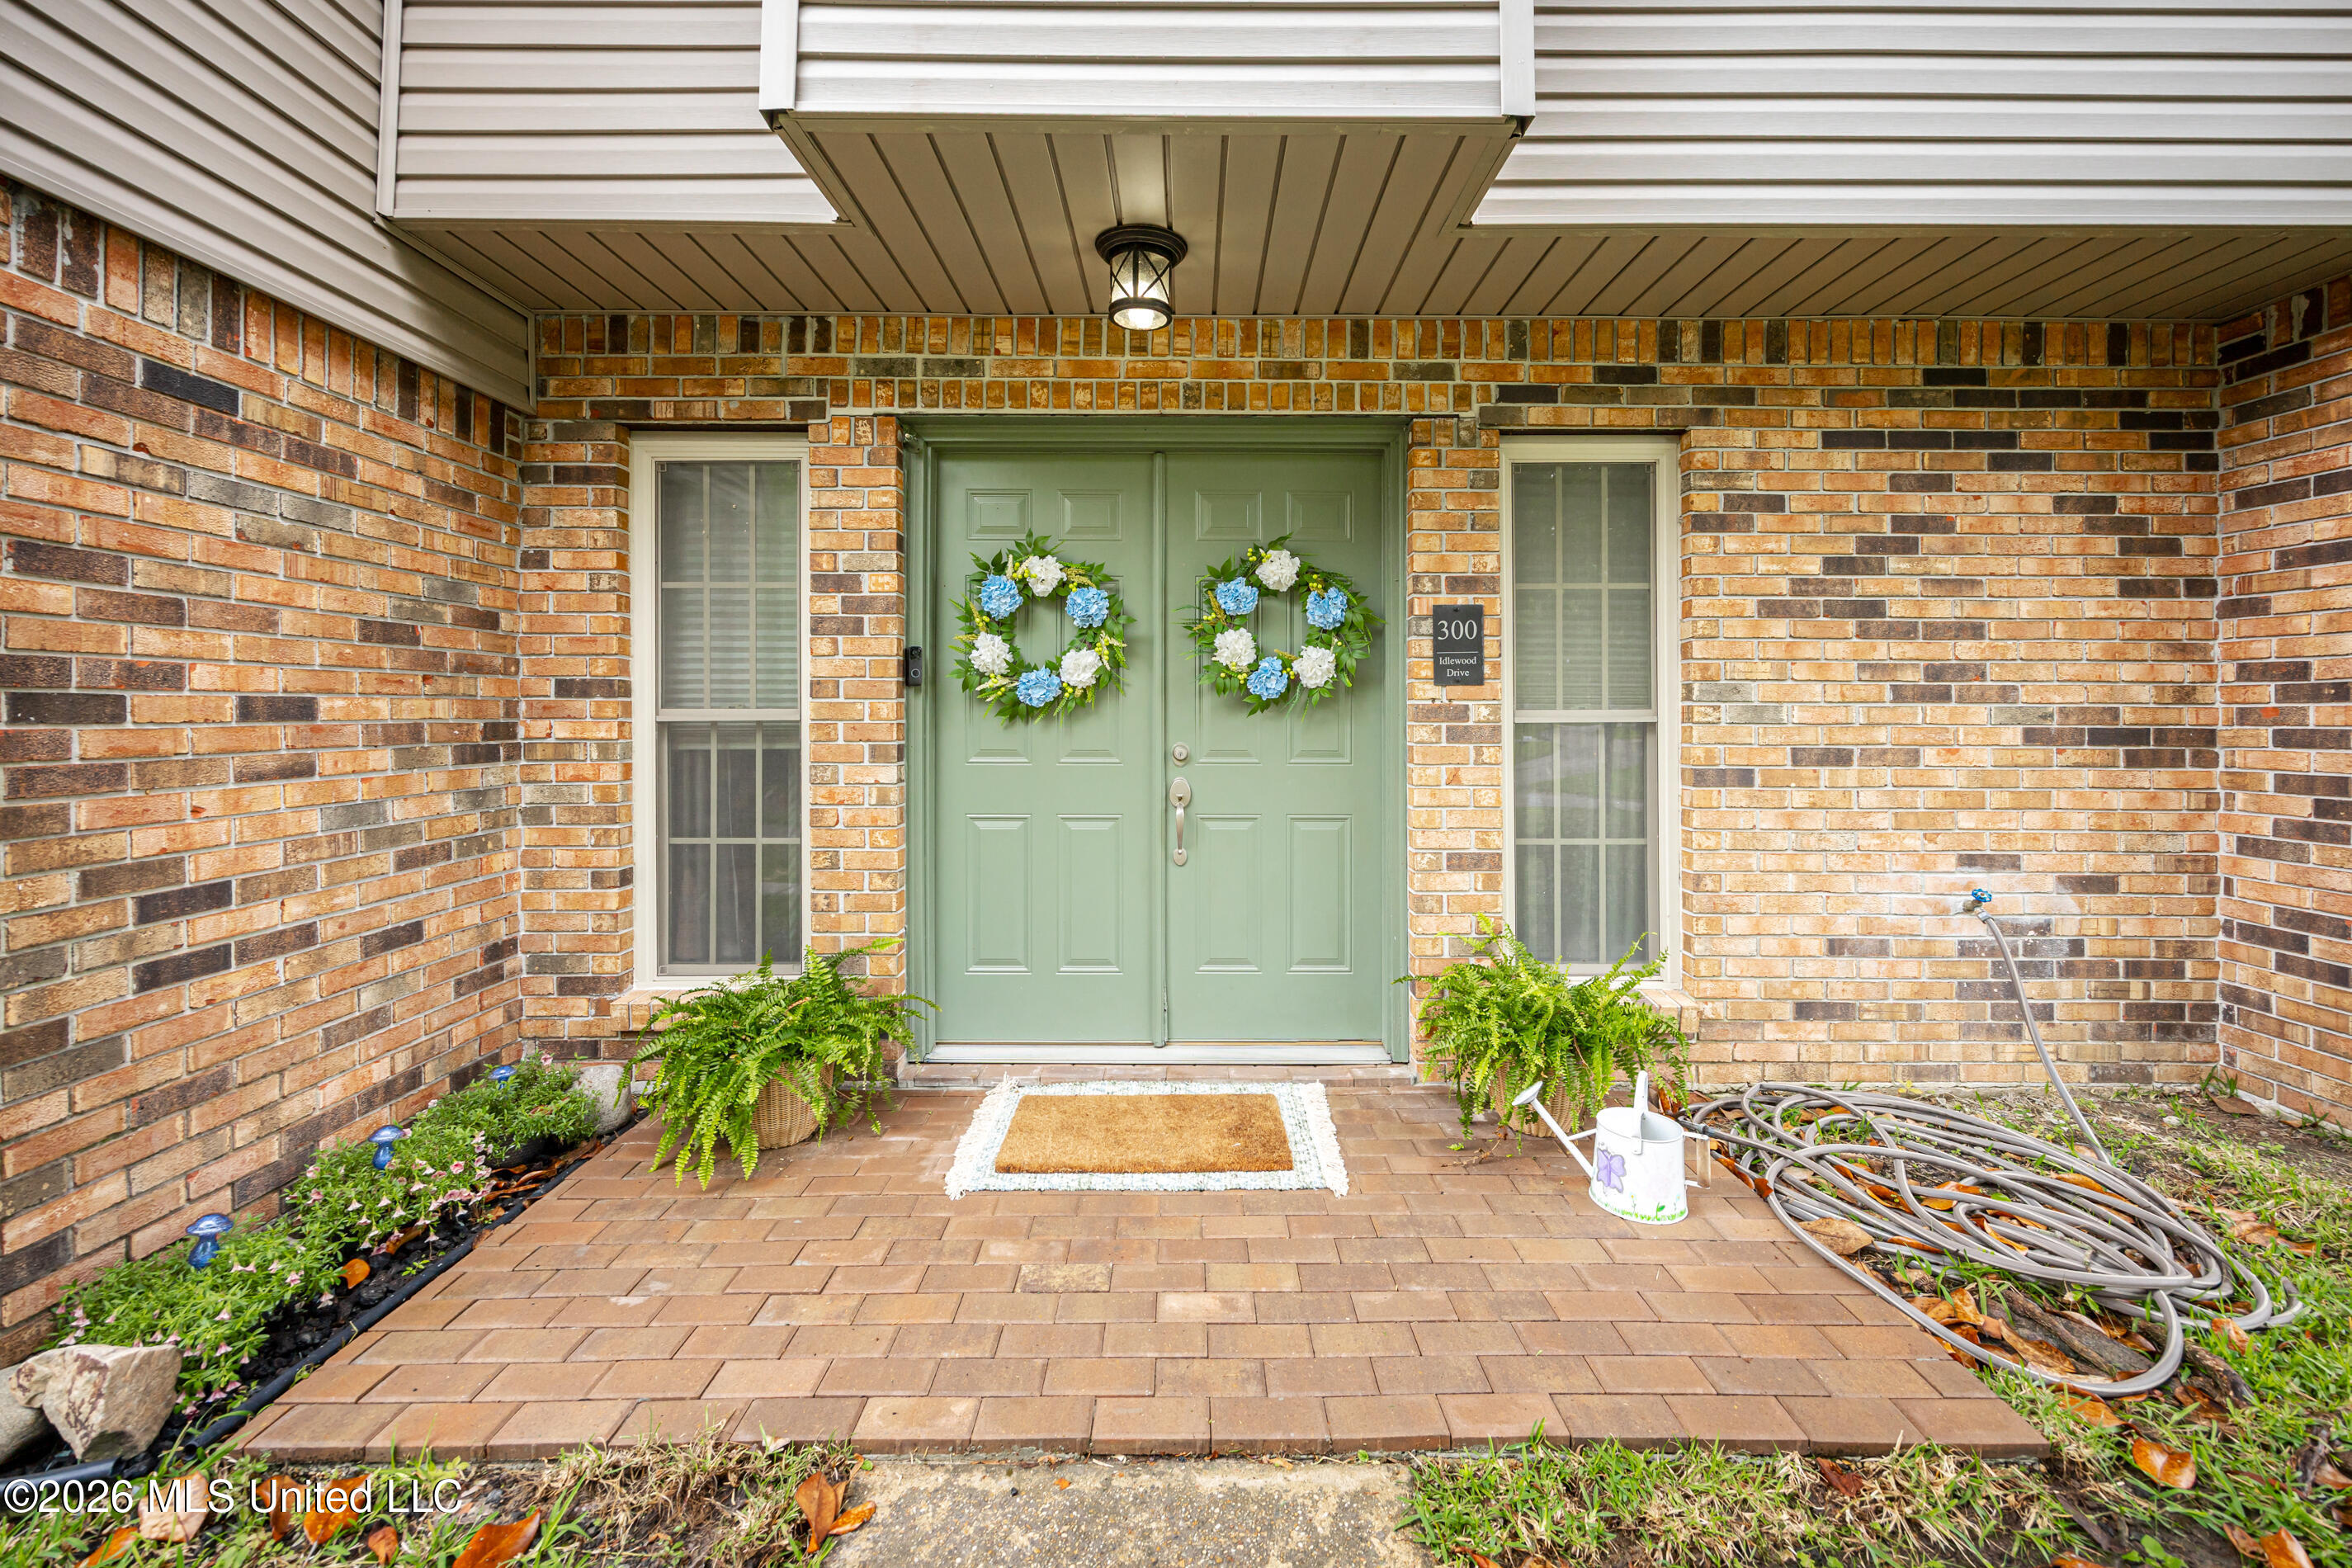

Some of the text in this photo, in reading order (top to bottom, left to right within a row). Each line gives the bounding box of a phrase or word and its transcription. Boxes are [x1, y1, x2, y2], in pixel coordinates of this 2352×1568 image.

[1438, 620, 1477, 640] 300
[1439, 656, 1477, 665] Idlewood
[1447, 668, 1470, 678] Drive
